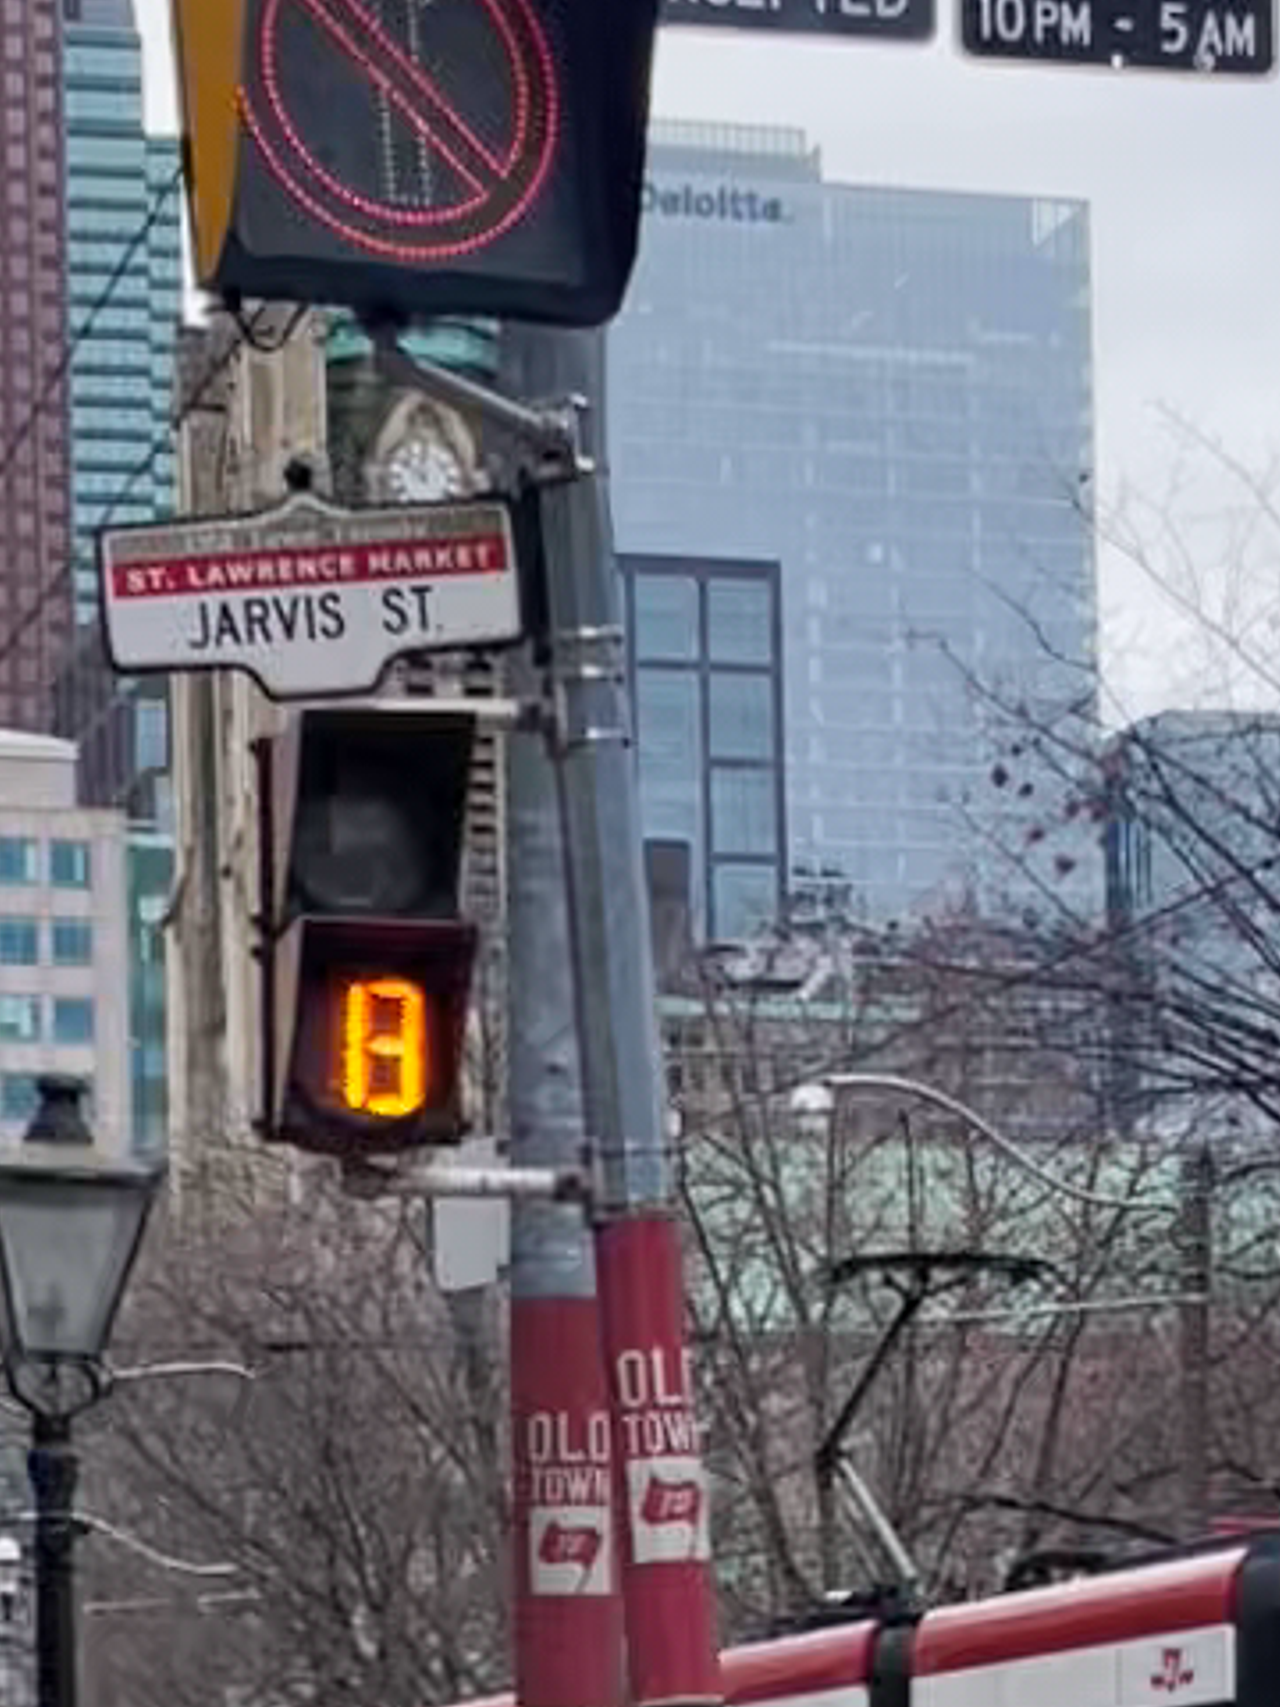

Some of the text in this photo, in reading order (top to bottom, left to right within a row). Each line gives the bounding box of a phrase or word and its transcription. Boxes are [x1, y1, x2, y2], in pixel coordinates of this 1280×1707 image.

[1160, 3, 1255, 58] 5AM
[126, 542, 490, 593] ST. LAWRENCE MARKET
[189, 591, 346, 650] JARVIS
[528, 1411, 611, 1462] OLD
